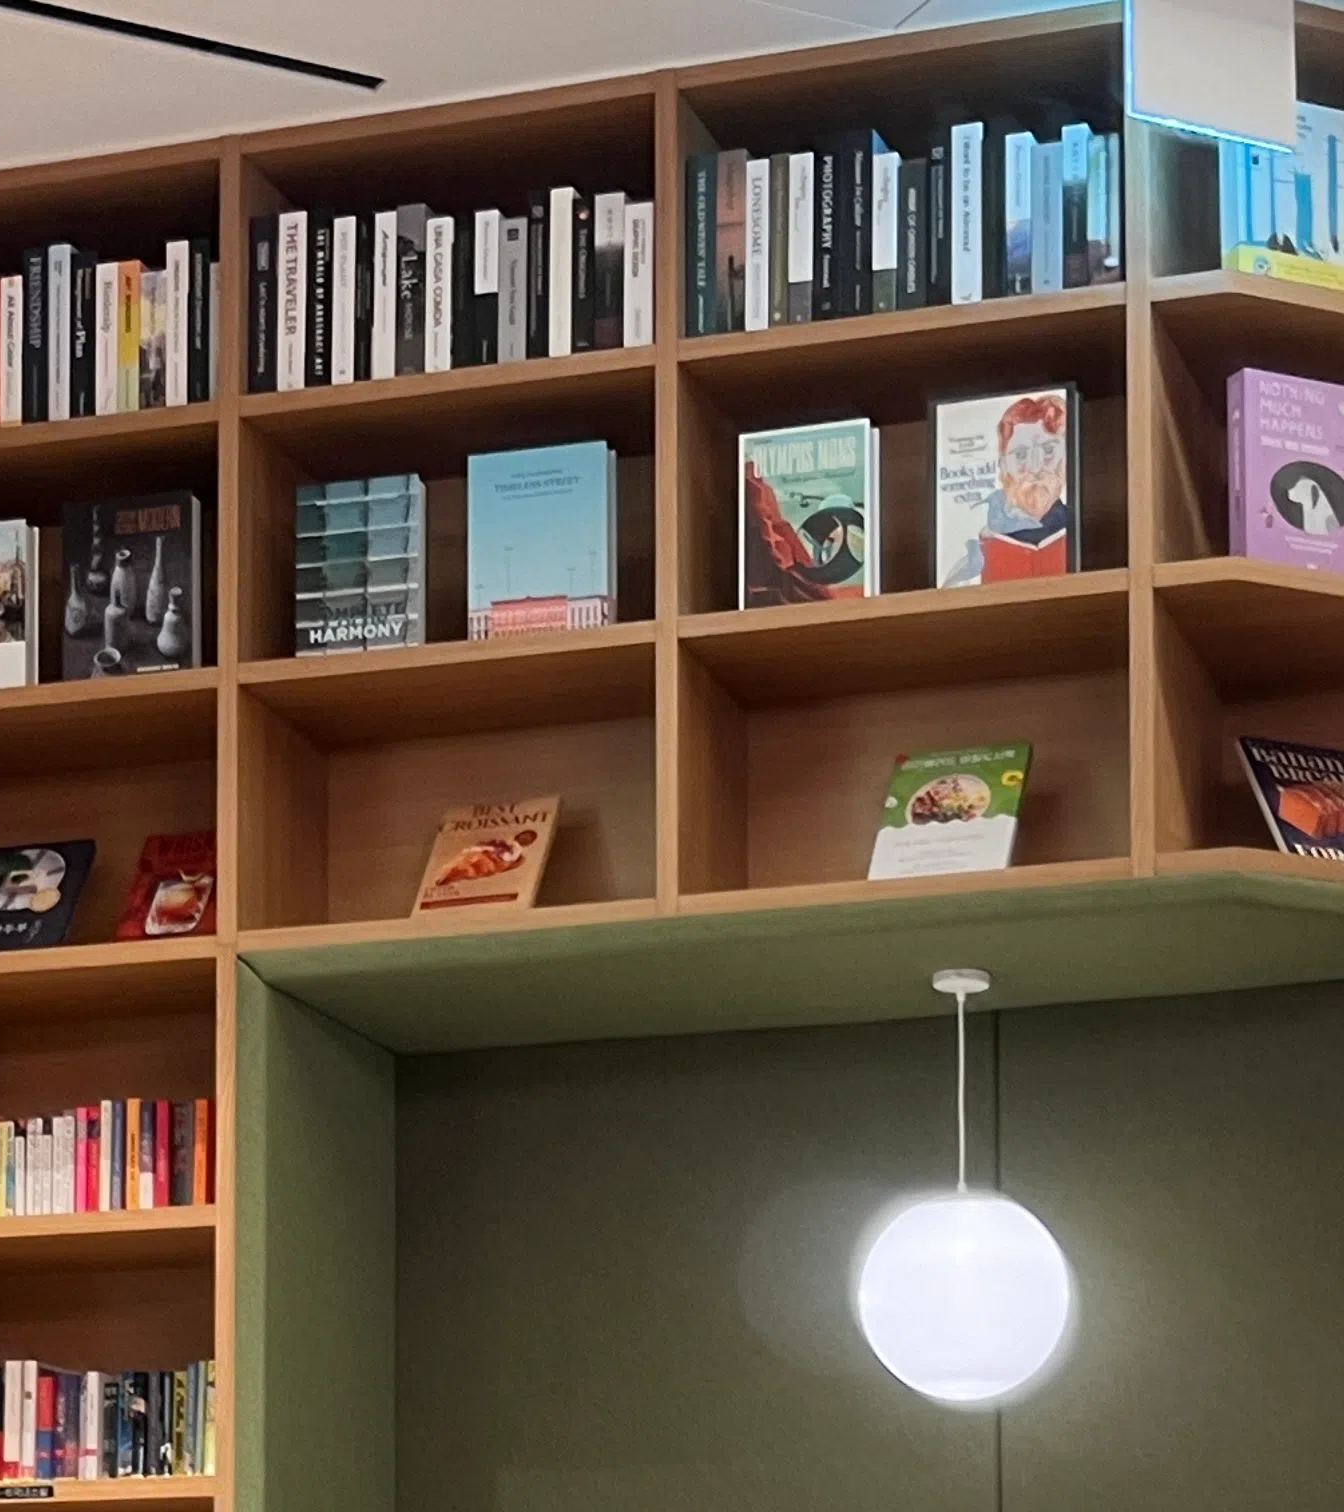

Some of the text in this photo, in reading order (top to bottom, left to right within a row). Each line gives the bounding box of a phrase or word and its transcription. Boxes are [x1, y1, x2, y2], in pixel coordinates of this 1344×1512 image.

[822, 156, 833, 249] PHOTOGRAPHY
[752, 177, 763, 257] LONESOME
[433, 224, 444, 249] UNA
[284, 223, 298, 335] THE TRAVELER
[400, 253, 419, 301] Lake
[433, 252, 444, 283] CASA
[28, 257, 42, 348] FRIENDSHIP
[1259, 381, 1325, 405] NOTHING
[1260, 398, 1302, 418] MUCH
[1260, 418, 1324, 440] HAPPENS
[940, 460, 996, 480] Books add
[309, 621, 402, 644] HARMONY
